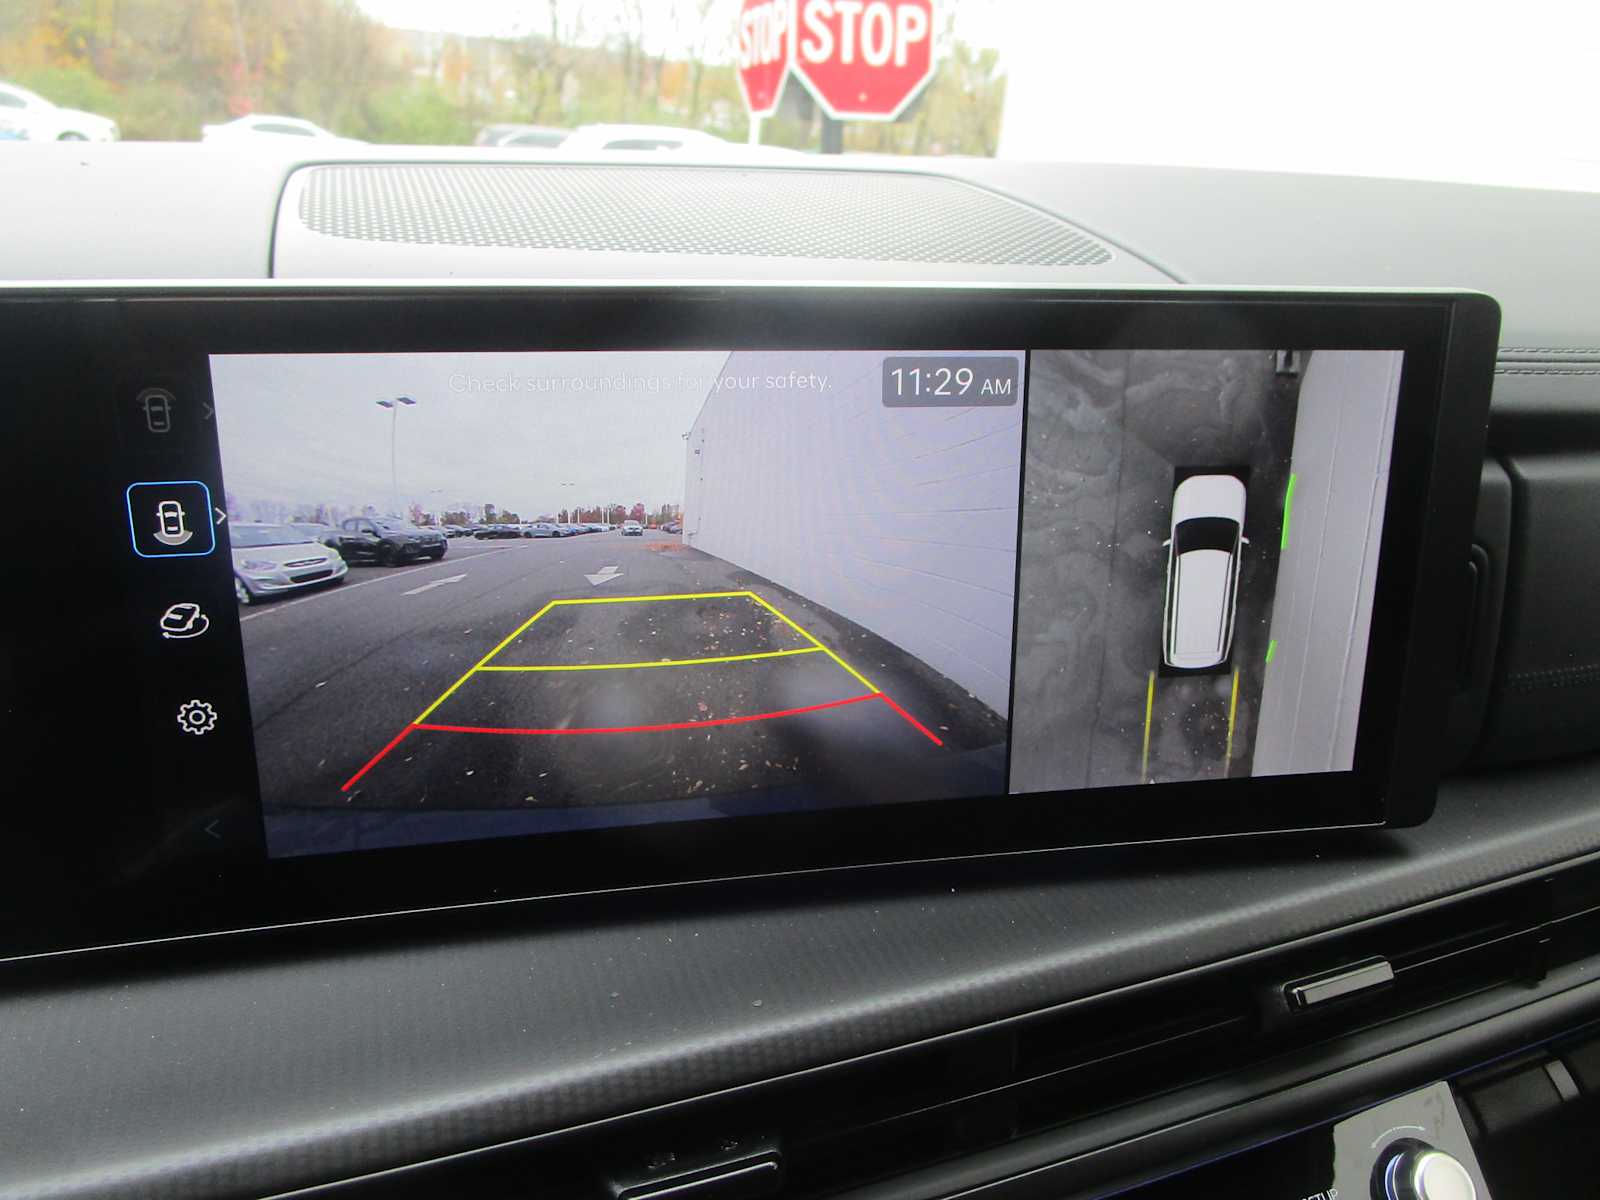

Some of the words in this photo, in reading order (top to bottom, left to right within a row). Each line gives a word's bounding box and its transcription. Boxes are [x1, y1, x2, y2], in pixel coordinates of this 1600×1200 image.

[738, 1, 787, 69] STOP
[801, 0, 928, 67] STOP
[448, 372, 520, 393] Check
[527, 371, 673, 394] surroundings
[713, 375, 760, 392] your
[765, 370, 832, 392] safety.
[891, 367, 974, 396] 11:29
[980, 378, 1012, 395] AM
